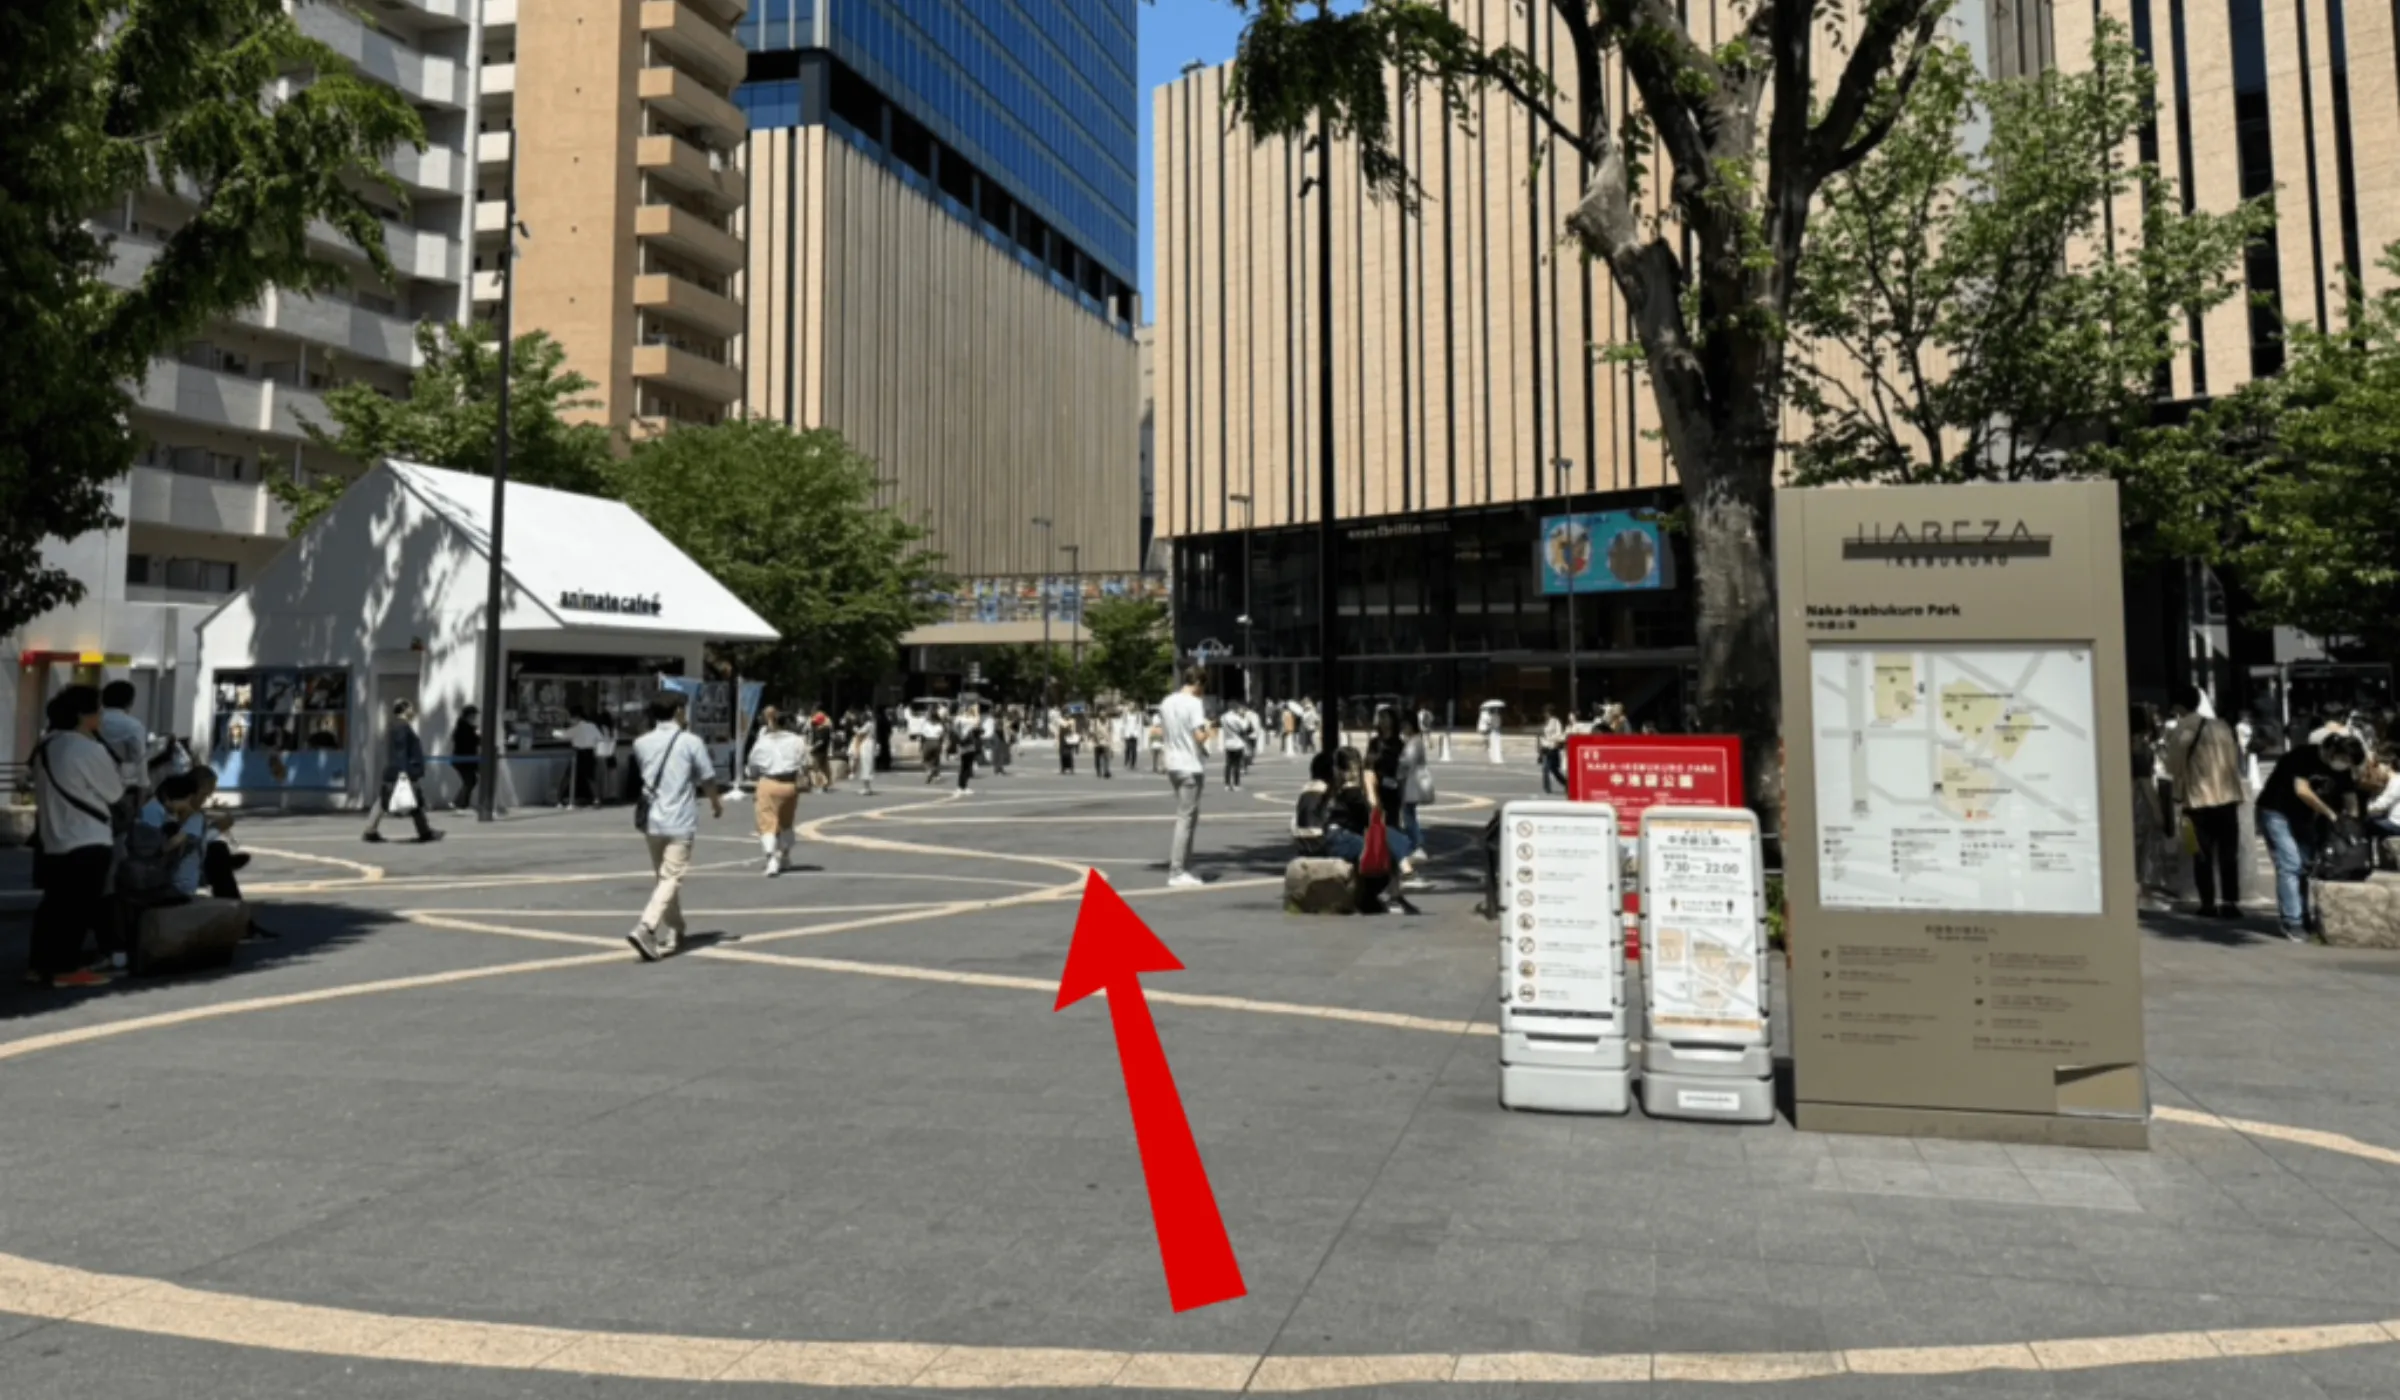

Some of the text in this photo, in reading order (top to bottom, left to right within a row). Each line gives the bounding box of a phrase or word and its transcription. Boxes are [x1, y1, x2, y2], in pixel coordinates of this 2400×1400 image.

[1806, 603, 1960, 616] Naka-Ikebukuro Park
[1610, 773, 1693, 788] 中池袋公園
